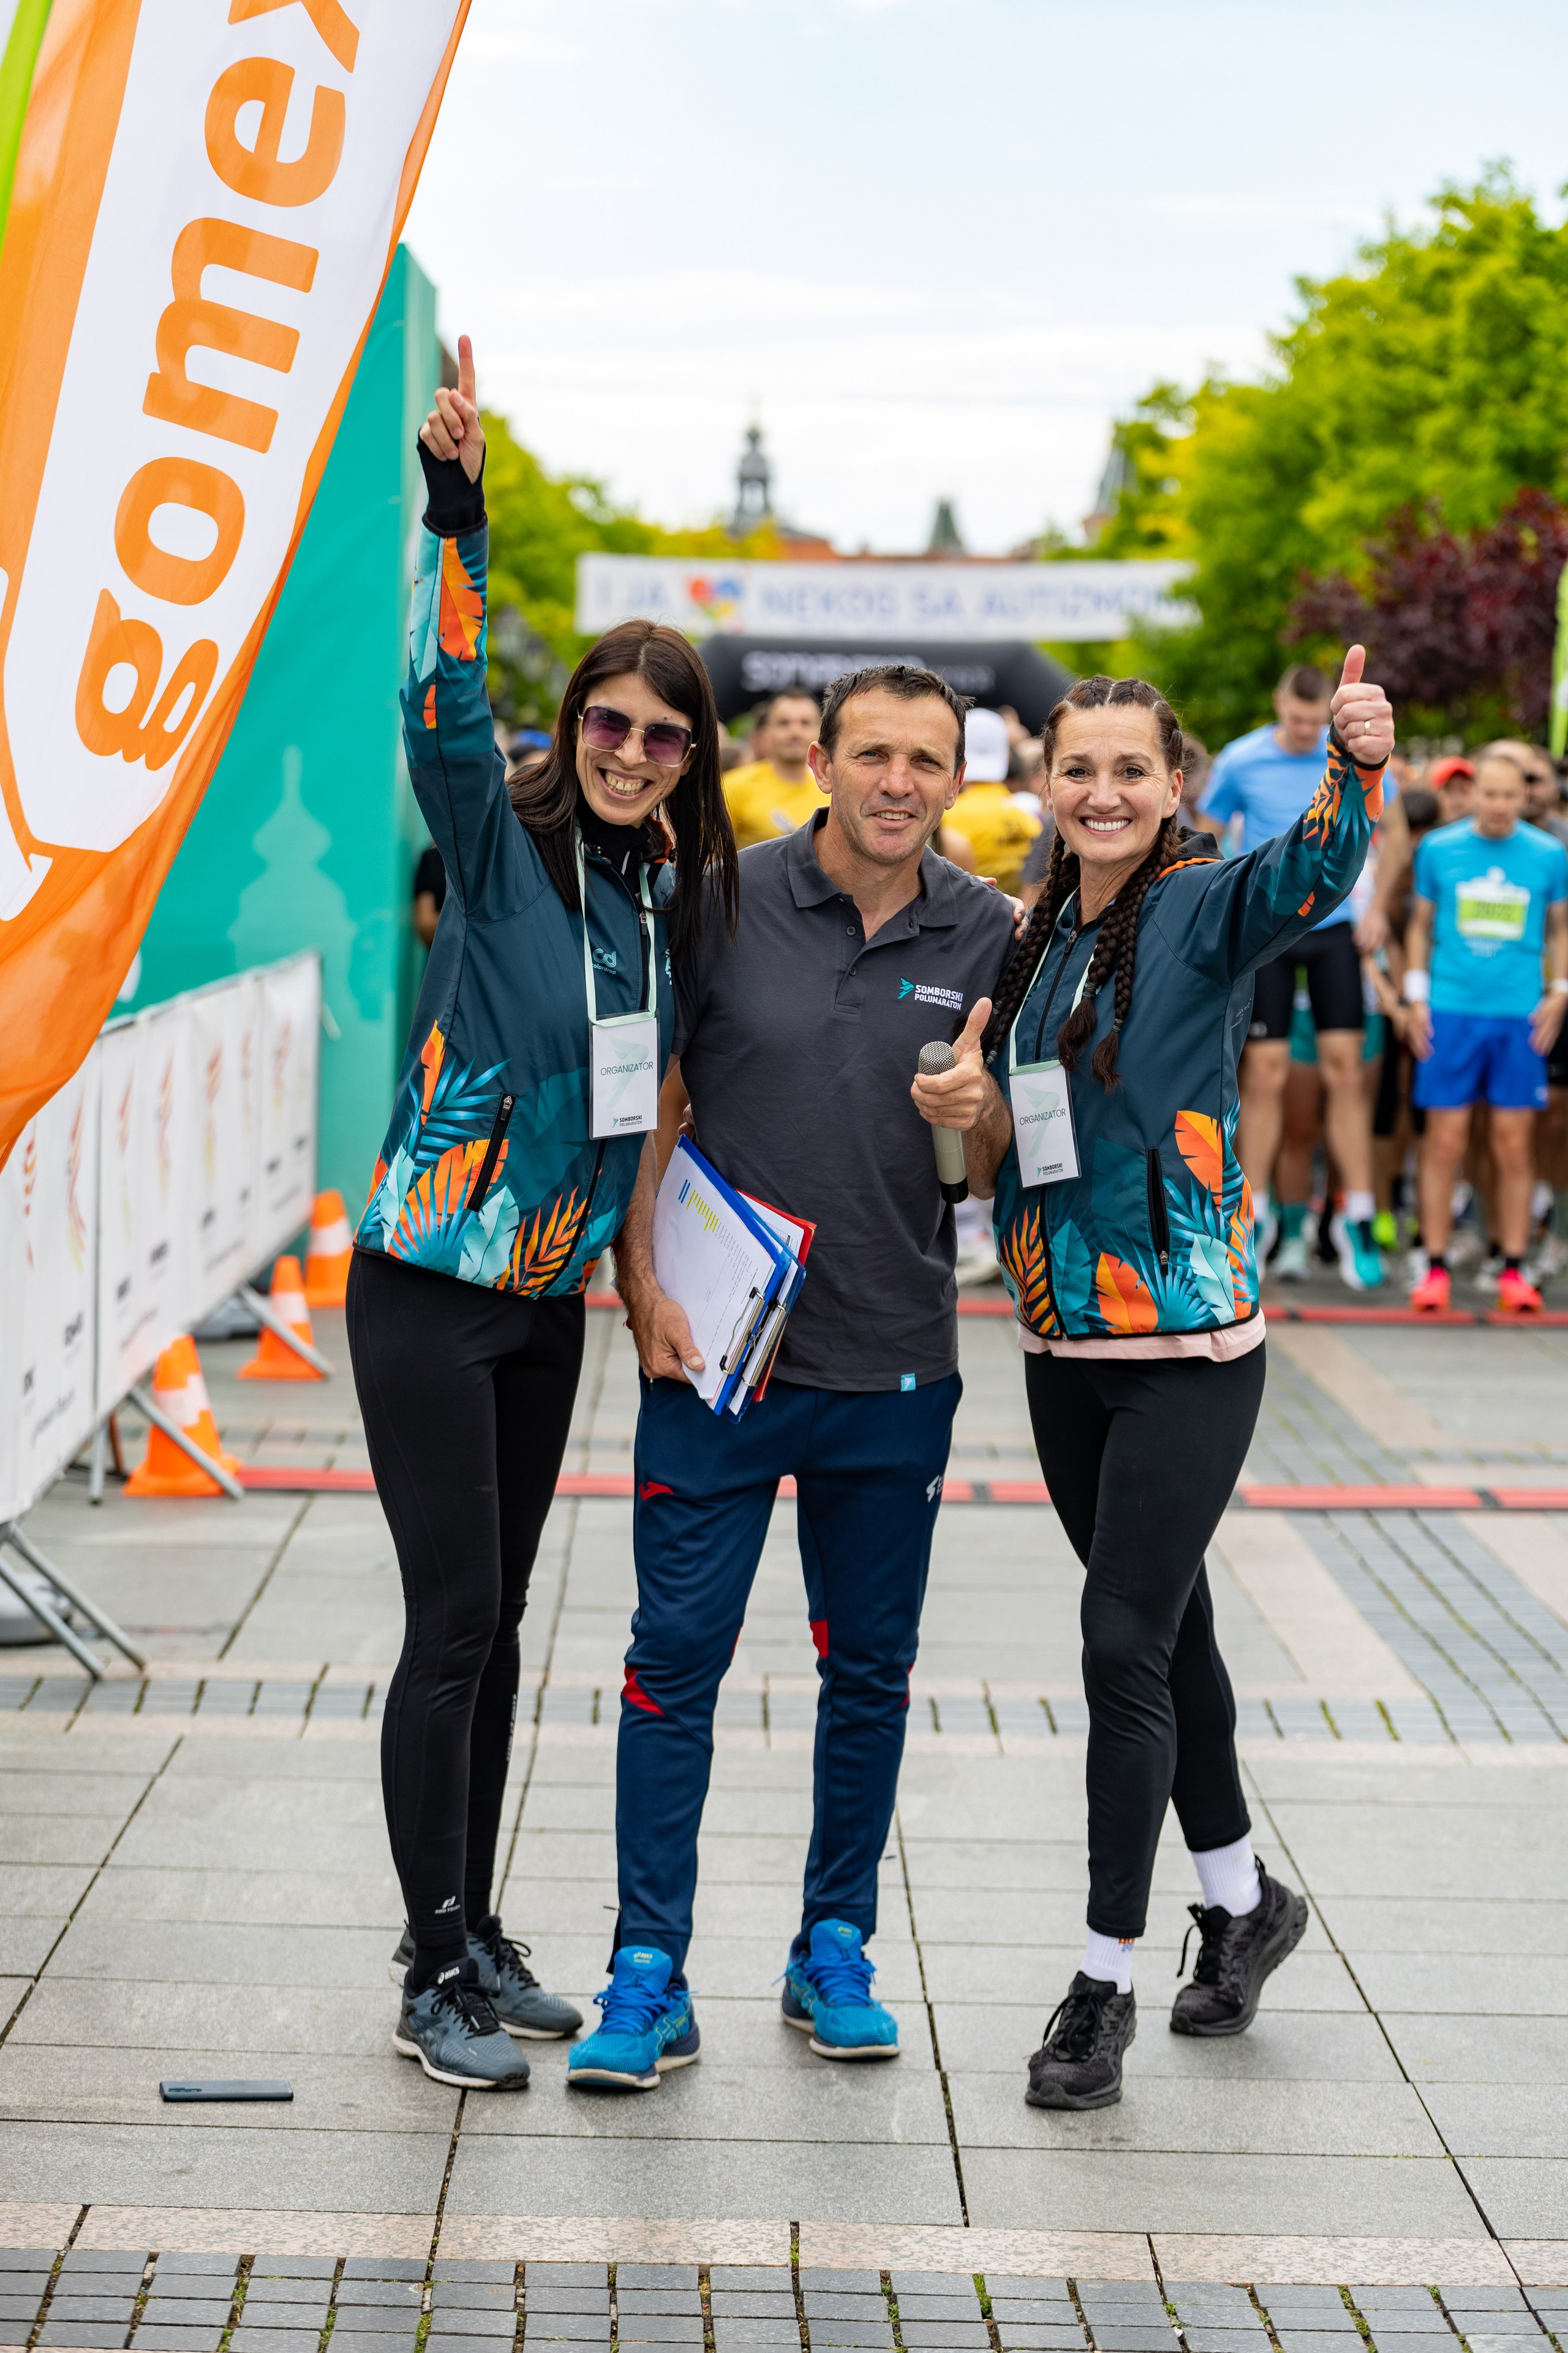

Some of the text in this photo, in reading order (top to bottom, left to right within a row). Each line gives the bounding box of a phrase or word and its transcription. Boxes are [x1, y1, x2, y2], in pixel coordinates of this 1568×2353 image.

[915, 984, 963, 1002] SOMBORSKI
[914, 994, 962, 1011] POLUMARATON
[600, 1061, 654, 1076] ORGANIZATOR
[1019, 1108, 1066, 1126] ORGANIZATOR
[1042, 1163, 1063, 1171] SOMBORSKI
[445, 1966, 460, 1980] asics
